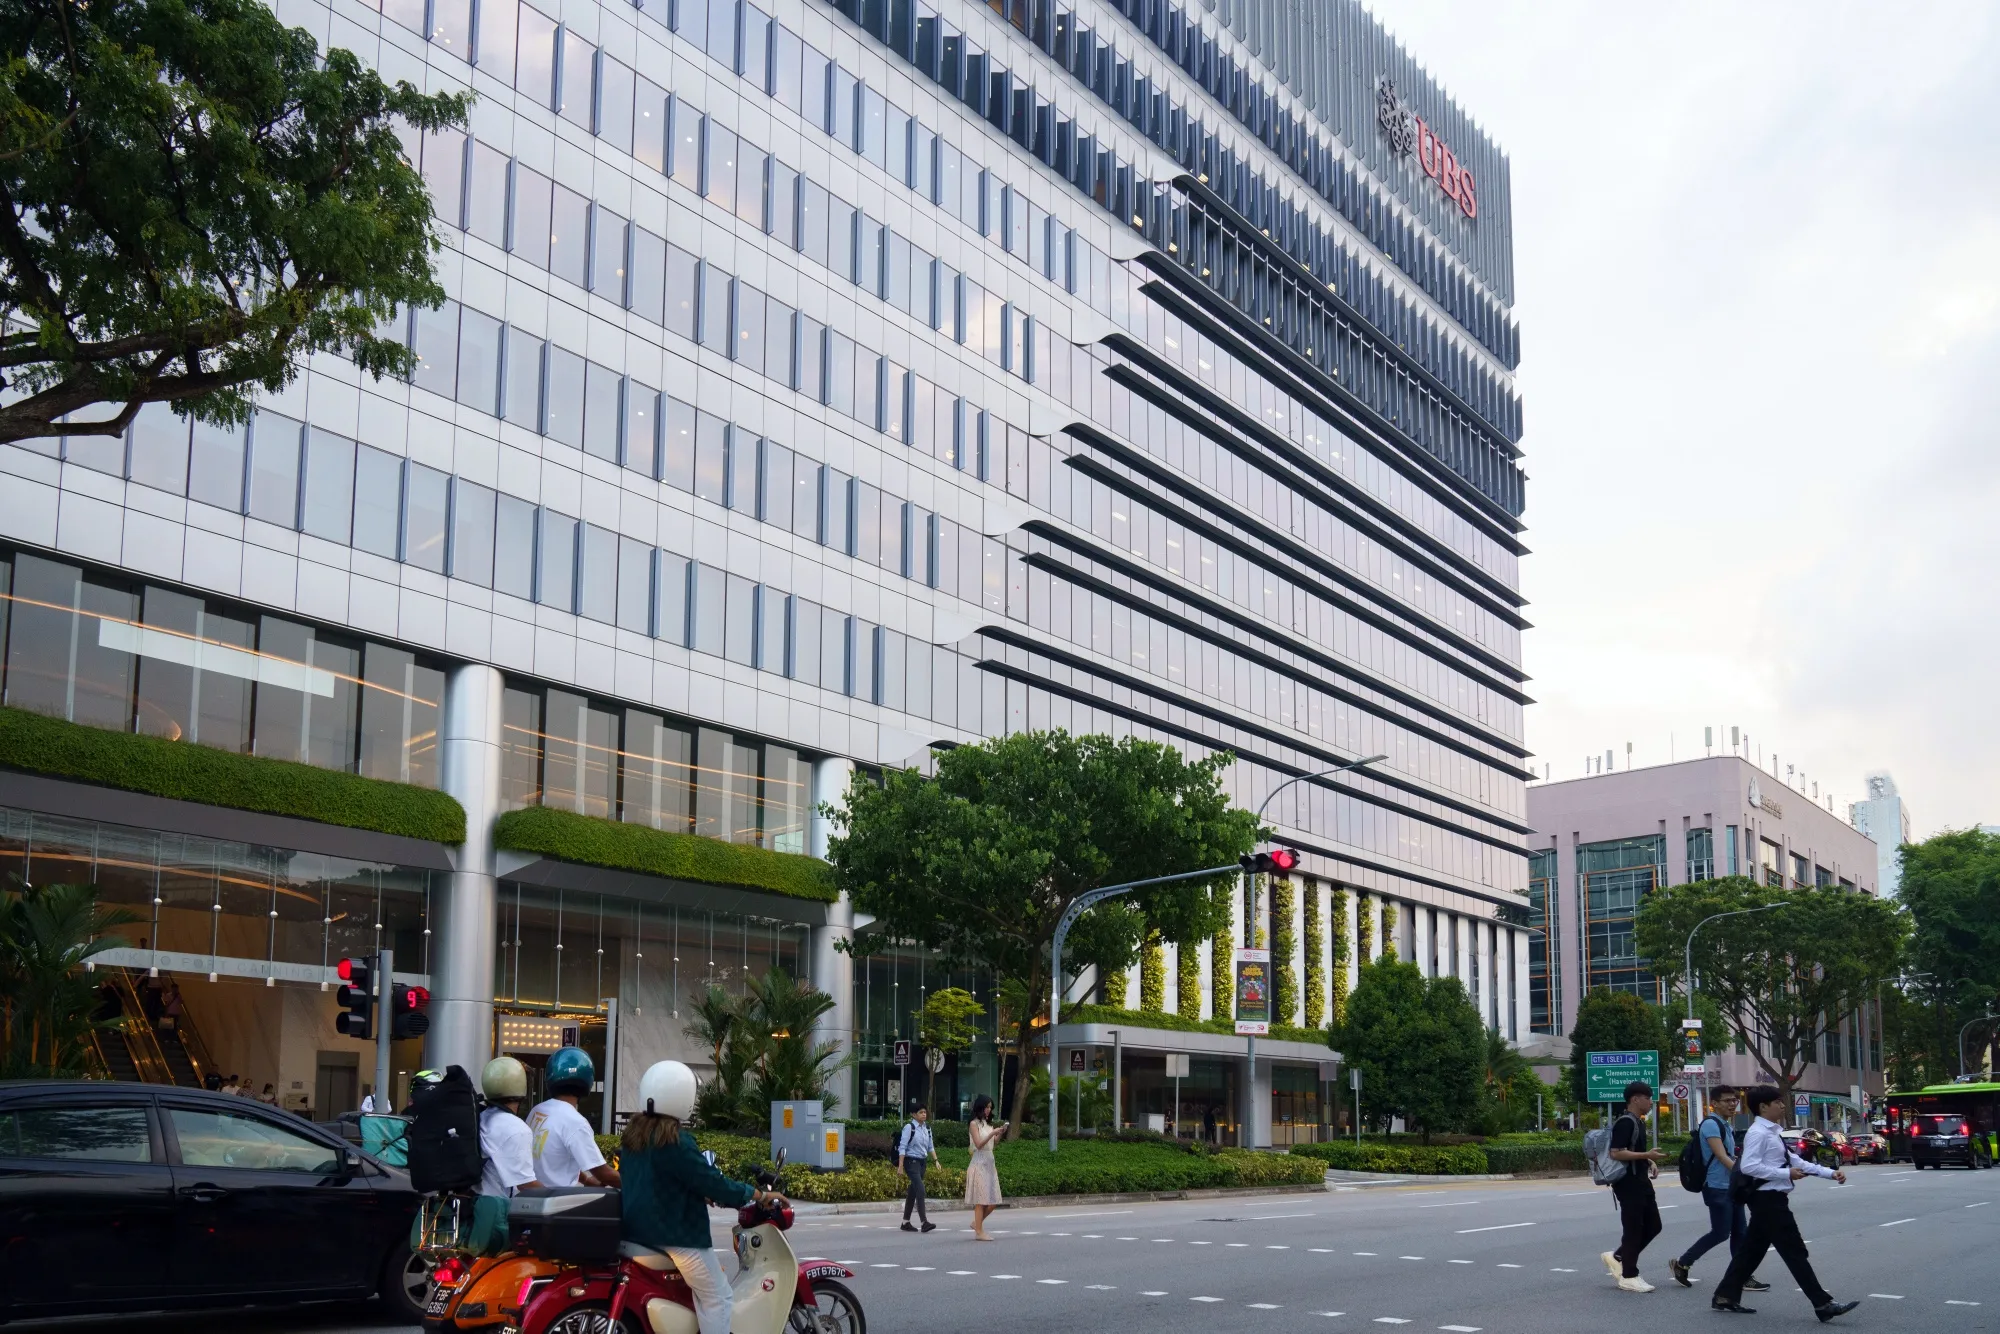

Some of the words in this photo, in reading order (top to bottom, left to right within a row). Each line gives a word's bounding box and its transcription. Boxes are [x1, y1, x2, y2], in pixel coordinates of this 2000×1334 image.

[1416, 116, 1477, 218] UBS
[96, 951, 138, 964] LINK
[1607, 1055, 1623, 1064] (SLE)
[1605, 1069, 1641, 1077] Clemenceau
[806, 1267, 821, 1279] FBT
[822, 1266, 845, 1277] 6767C
[436, 1290, 450, 1300] FBF
